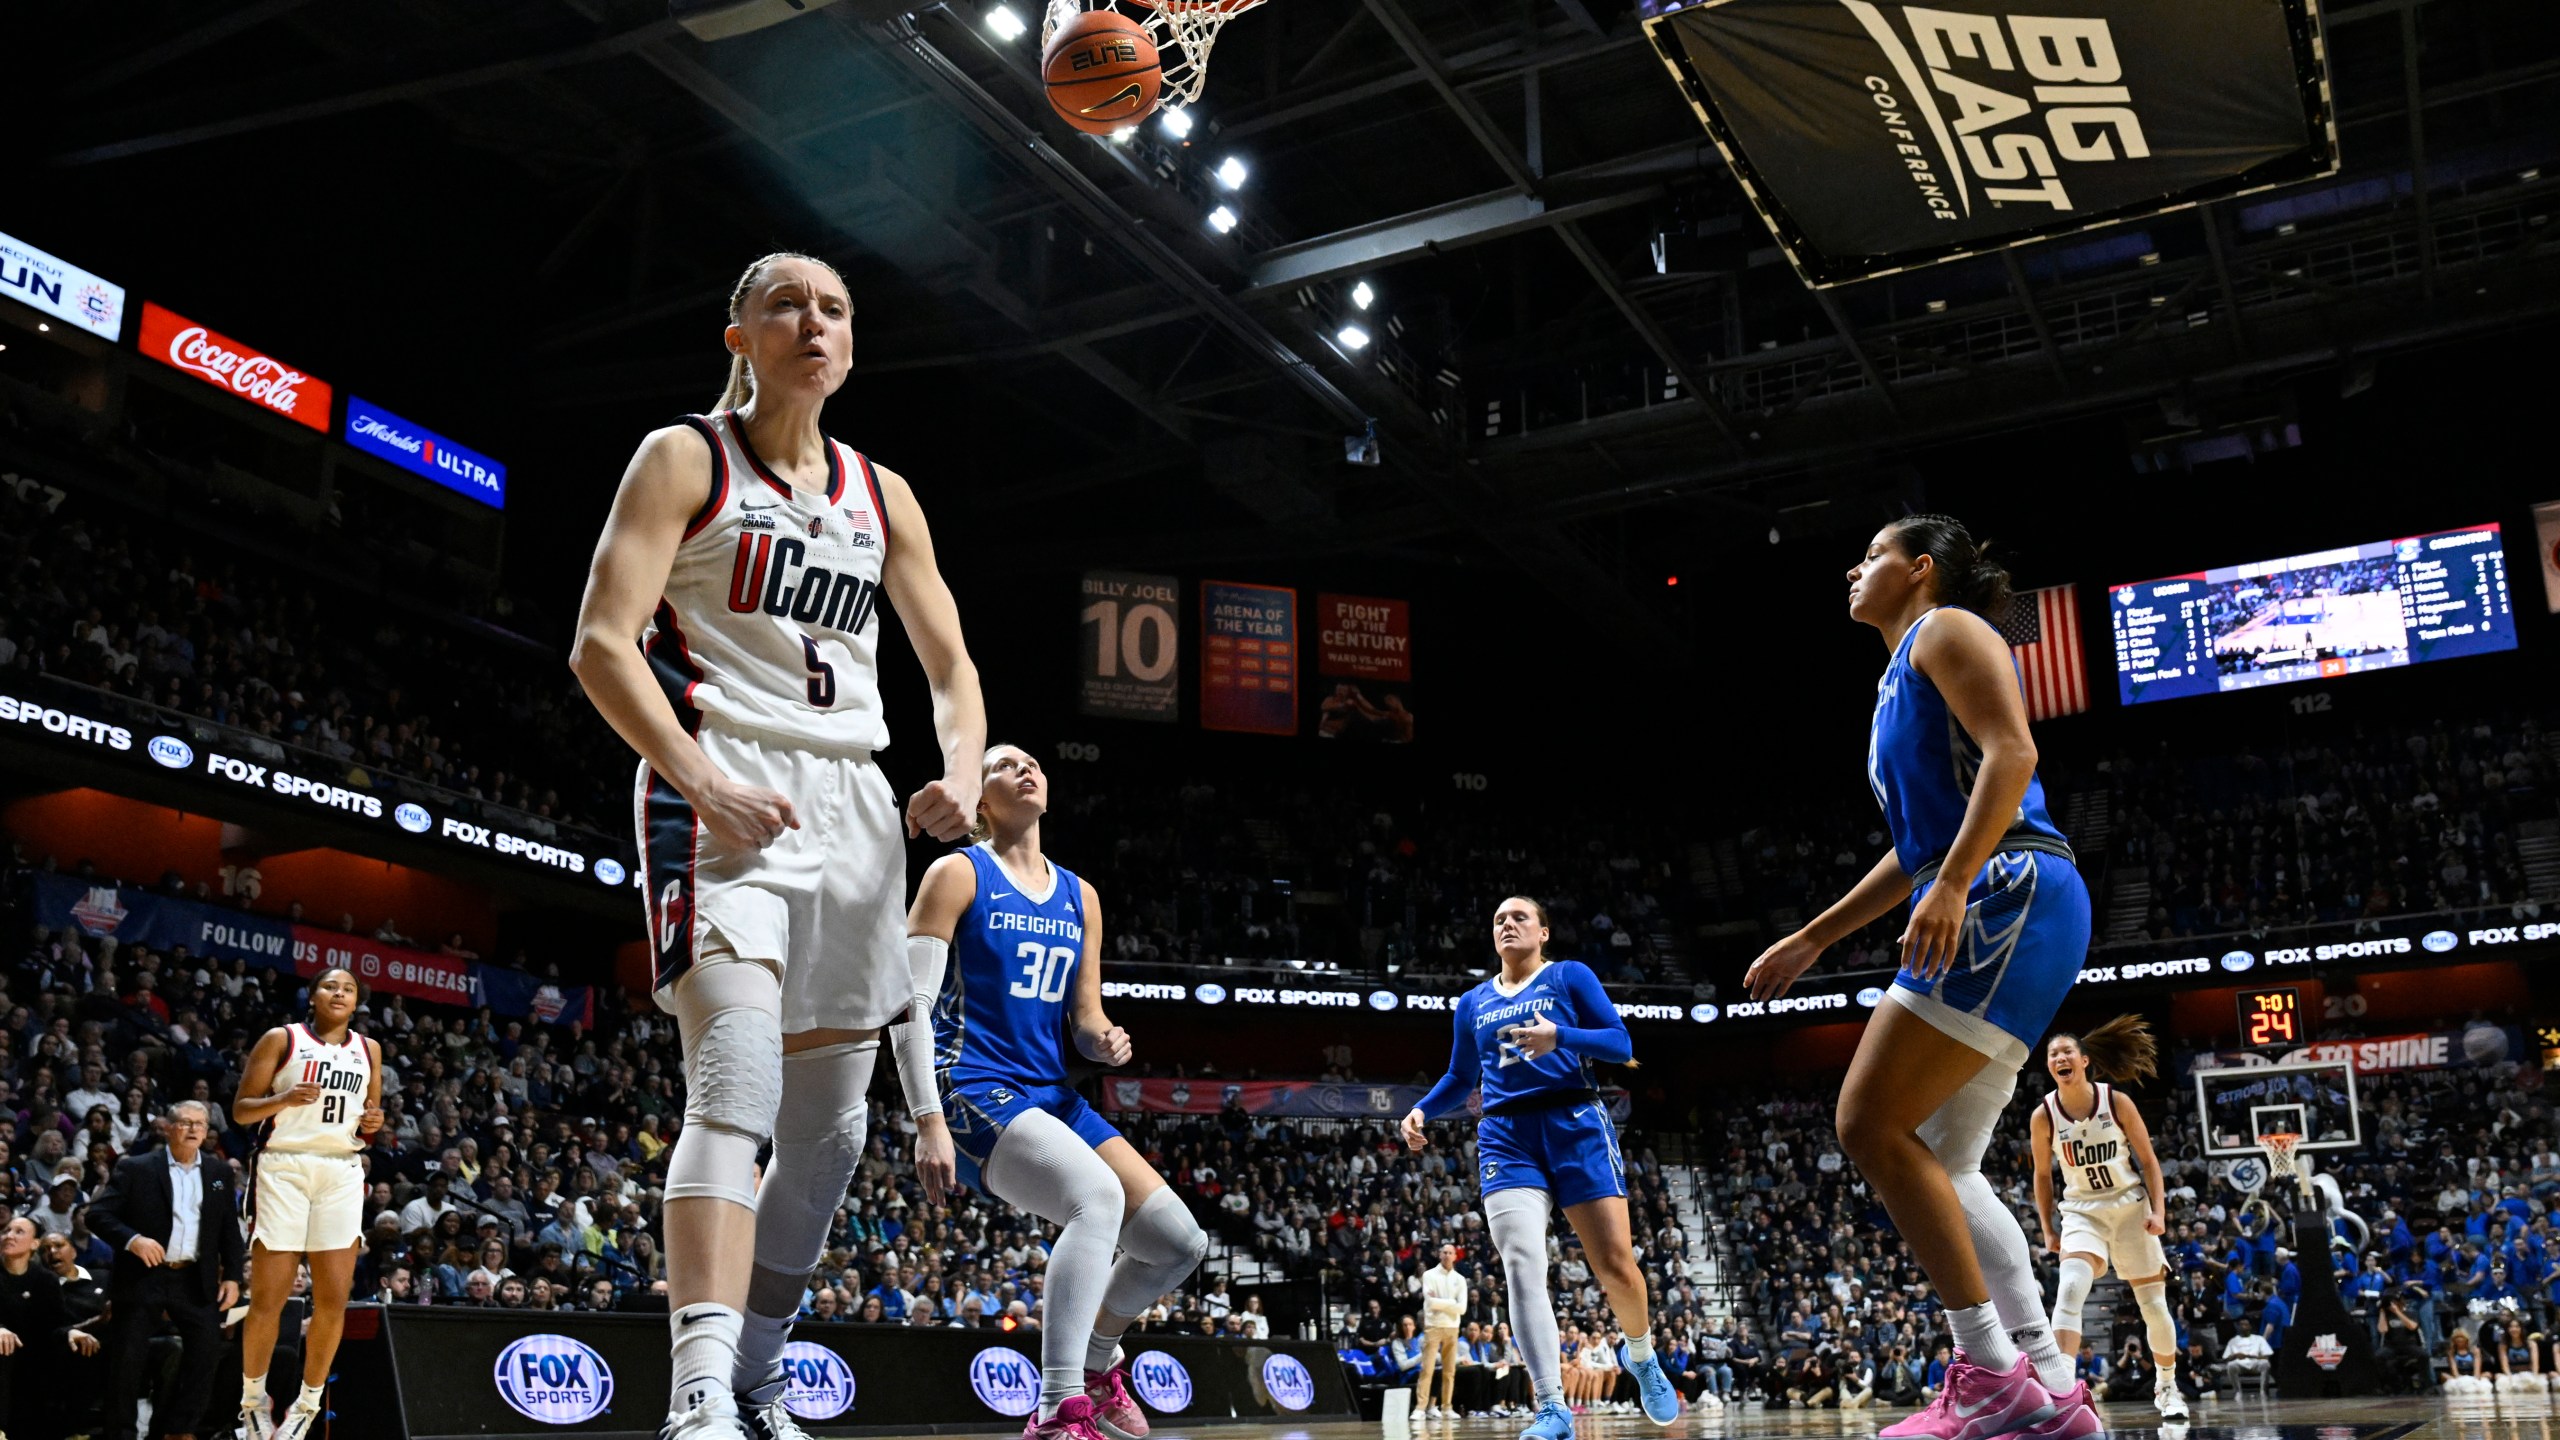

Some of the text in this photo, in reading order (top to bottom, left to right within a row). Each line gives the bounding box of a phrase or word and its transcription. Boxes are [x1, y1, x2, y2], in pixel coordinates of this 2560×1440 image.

[2006, 14, 2150, 161] BIG
[1903, 7, 2073, 211] EAST
[1864, 75, 1957, 220] CONFERENCE
[169, 326, 306, 414] Coca-Cola
[351, 415, 500, 492] Michelob ULTRA
[741, 519, 776, 530] CHANGE
[745, 512, 754, 520] BE
[852, 539, 875, 547] EAST
[728, 532, 876, 636] UConn
[1082, 579, 1176, 602] BILLY JOEL
[1213, 604, 1285, 622] ARENA OF
[1336, 602, 1391, 621] FIGHT
[1215, 618, 1284, 636] THE YEAR
[1341, 618, 1387, 634] OF THE
[2418, 629, 2447, 640] Team
[2447, 624, 2474, 636] Fouls
[1081, 599, 1178, 682] 10
[1322, 630, 1407, 652] CENTURY
[2189, 640, 2196, 650] 7
[1327, 653, 1357, 664] WARD
[2186, 651, 2197, 661] 11
[2263, 668, 2280, 682] 42
[2391, 650, 2409, 663] 22
[799, 633, 836, 708] 5
[2131, 672, 2157, 683] Team
[2157, 668, 2181, 679] Fouls
[2290, 693, 2333, 714] 112
[0, 695, 132, 750] SPORTS
[159, 742, 182, 759] FOX
[1056, 742, 1099, 761] 109
[207, 752, 383, 818] FOX SPORTS
[1453, 772, 1487, 790] 110
[404, 809, 422, 822] FOX
[442, 817, 585, 873] FOX SPORTS
[218, 865, 262, 899] 16
[989, 911, 1082, 943] CREIGHTON
[2468, 926, 2519, 946] FOX
[201, 921, 478, 995] FOLLOW US ON @BIGEAST
[2264, 938, 2412, 966] FOX SPORTS
[1009, 941, 1076, 1003] 30
[2075, 958, 2211, 984] FOX SPORTS
[1101, 982, 1186, 1001] SPORTS
[1234, 987, 1360, 1007] FOX SPORTS
[1406, 994, 1446, 1010] FOX
[2254, 993, 2294, 1012] 7:01
[1476, 997, 1555, 1030] CREIGHTON
[1726, 994, 1848, 1019] FOX SPORTS
[2323, 994, 2368, 1019] 20
[2251, 1012, 2293, 1044] 24
[2358, 1036, 2449, 1070] SHINE
[303, 1060, 364, 1095] UConn
[321, 1095, 346, 1124] 21
[1367, 1086, 1392, 1113] MU
[2061, 1139, 2117, 1168] UConn
[2085, 1164, 2115, 1191] 20
[519, 1353, 588, 1389] FOX
[782, 1358, 836, 1389] FOX
[984, 1361, 1027, 1389] FOX
[1143, 1364, 1179, 1388] FOX
[1272, 1366, 1303, 1388] FOX
[525, 1390, 592, 1404] SPORTS
[788, 1390, 840, 1402] SPORTS
[991, 1390, 1031, 1400] SPORTS
